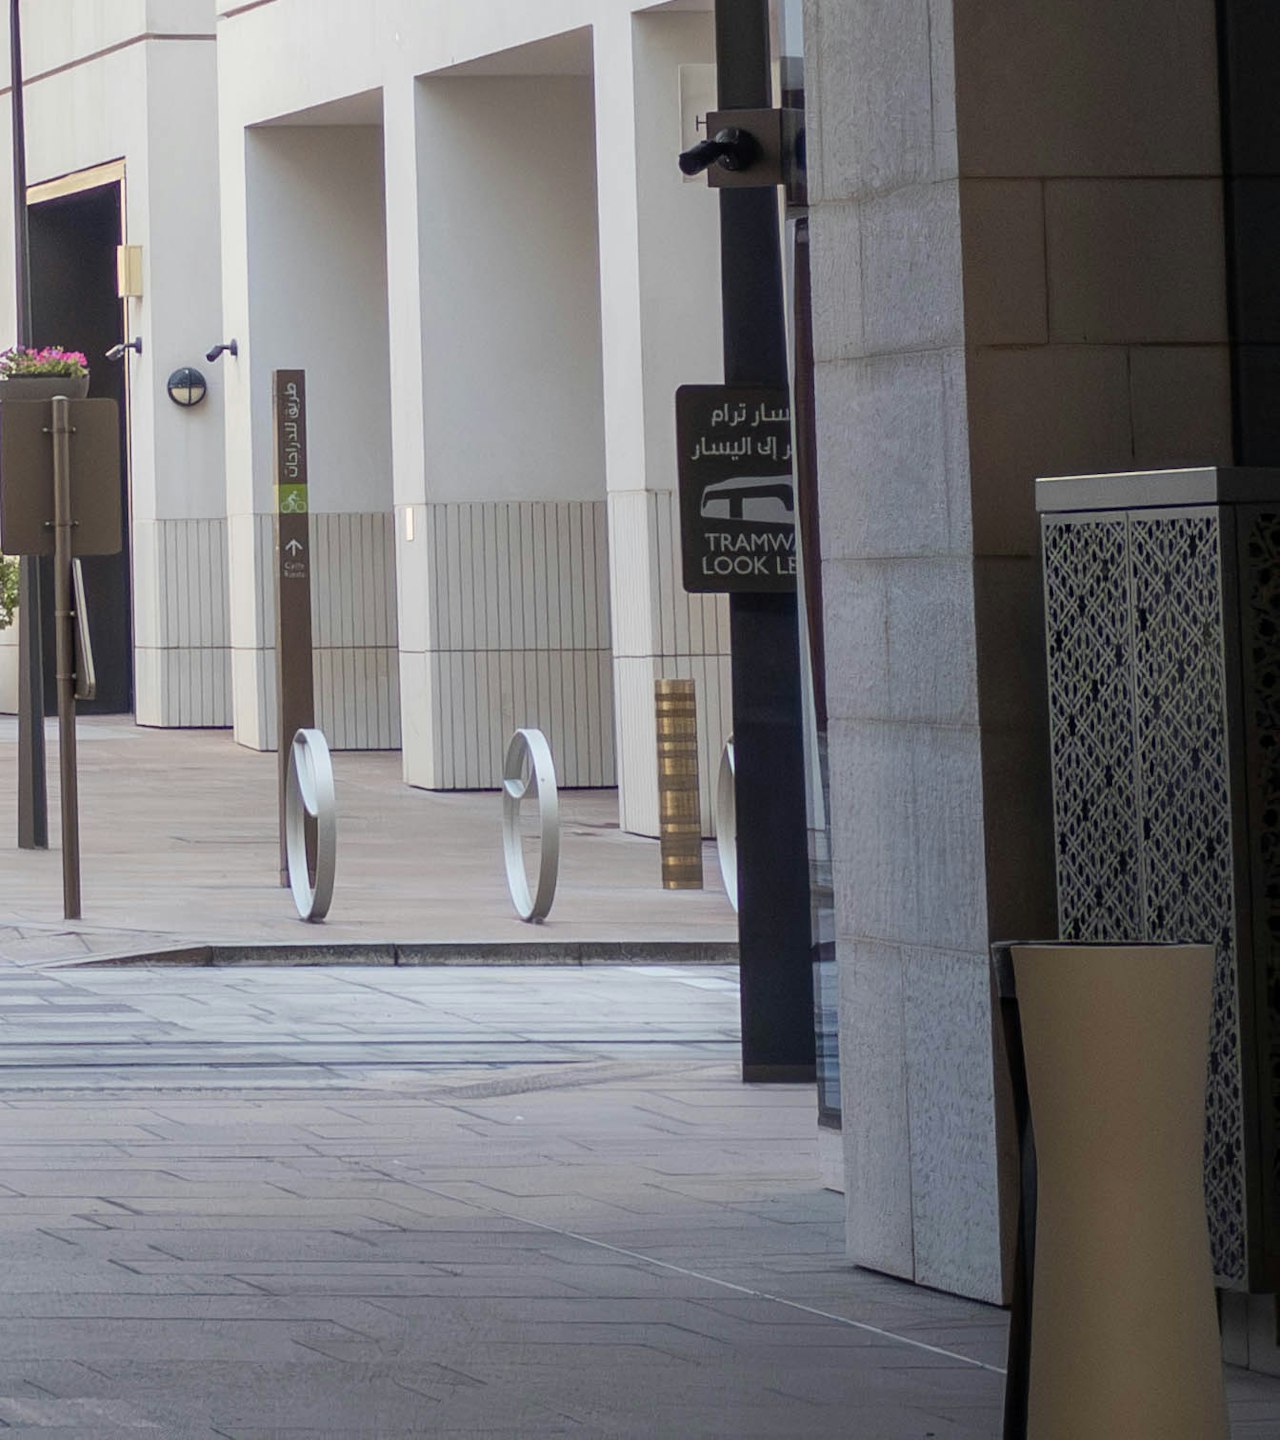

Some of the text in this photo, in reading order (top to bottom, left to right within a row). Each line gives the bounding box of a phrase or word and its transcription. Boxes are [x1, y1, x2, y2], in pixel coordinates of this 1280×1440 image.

[284, 382, 300, 419] طريق
[711, 403, 746, 427] ترام
[691, 436, 751, 461] اليسار
[704, 533, 796, 552] TRAMW
[702, 556, 797, 575] LOOK LE
